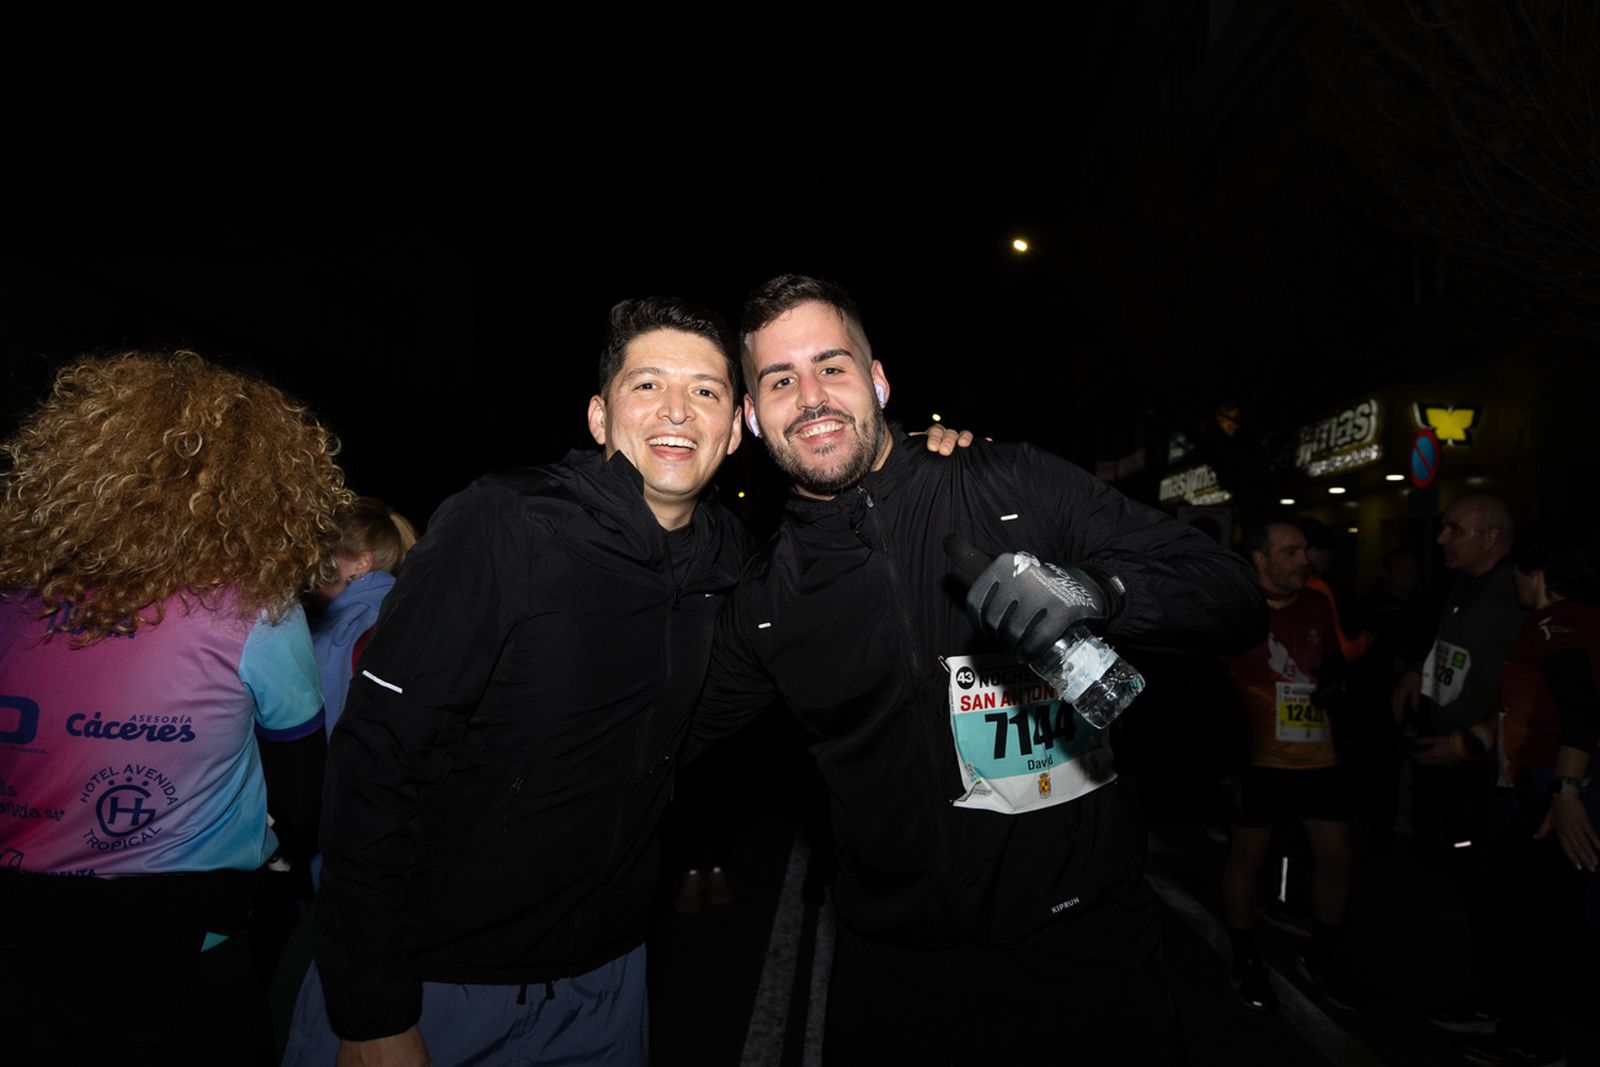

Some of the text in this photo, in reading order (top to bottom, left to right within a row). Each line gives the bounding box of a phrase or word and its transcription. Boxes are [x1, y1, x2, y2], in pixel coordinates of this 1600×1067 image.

[956, 670, 1032, 688] 43 NOCHE
[961, 691, 995, 711] SAN
[66, 711, 197, 743] Cáceres
[129, 714, 193, 724] ASESORÍA
[985, 701, 1074, 760] 7144
[1027, 754, 1054, 771] David
[80, 763, 179, 807] HOTEL AVENIDA
[83, 827, 162, 851] TROPICAL
[1050, 896, 1081, 914] KIPRUN
